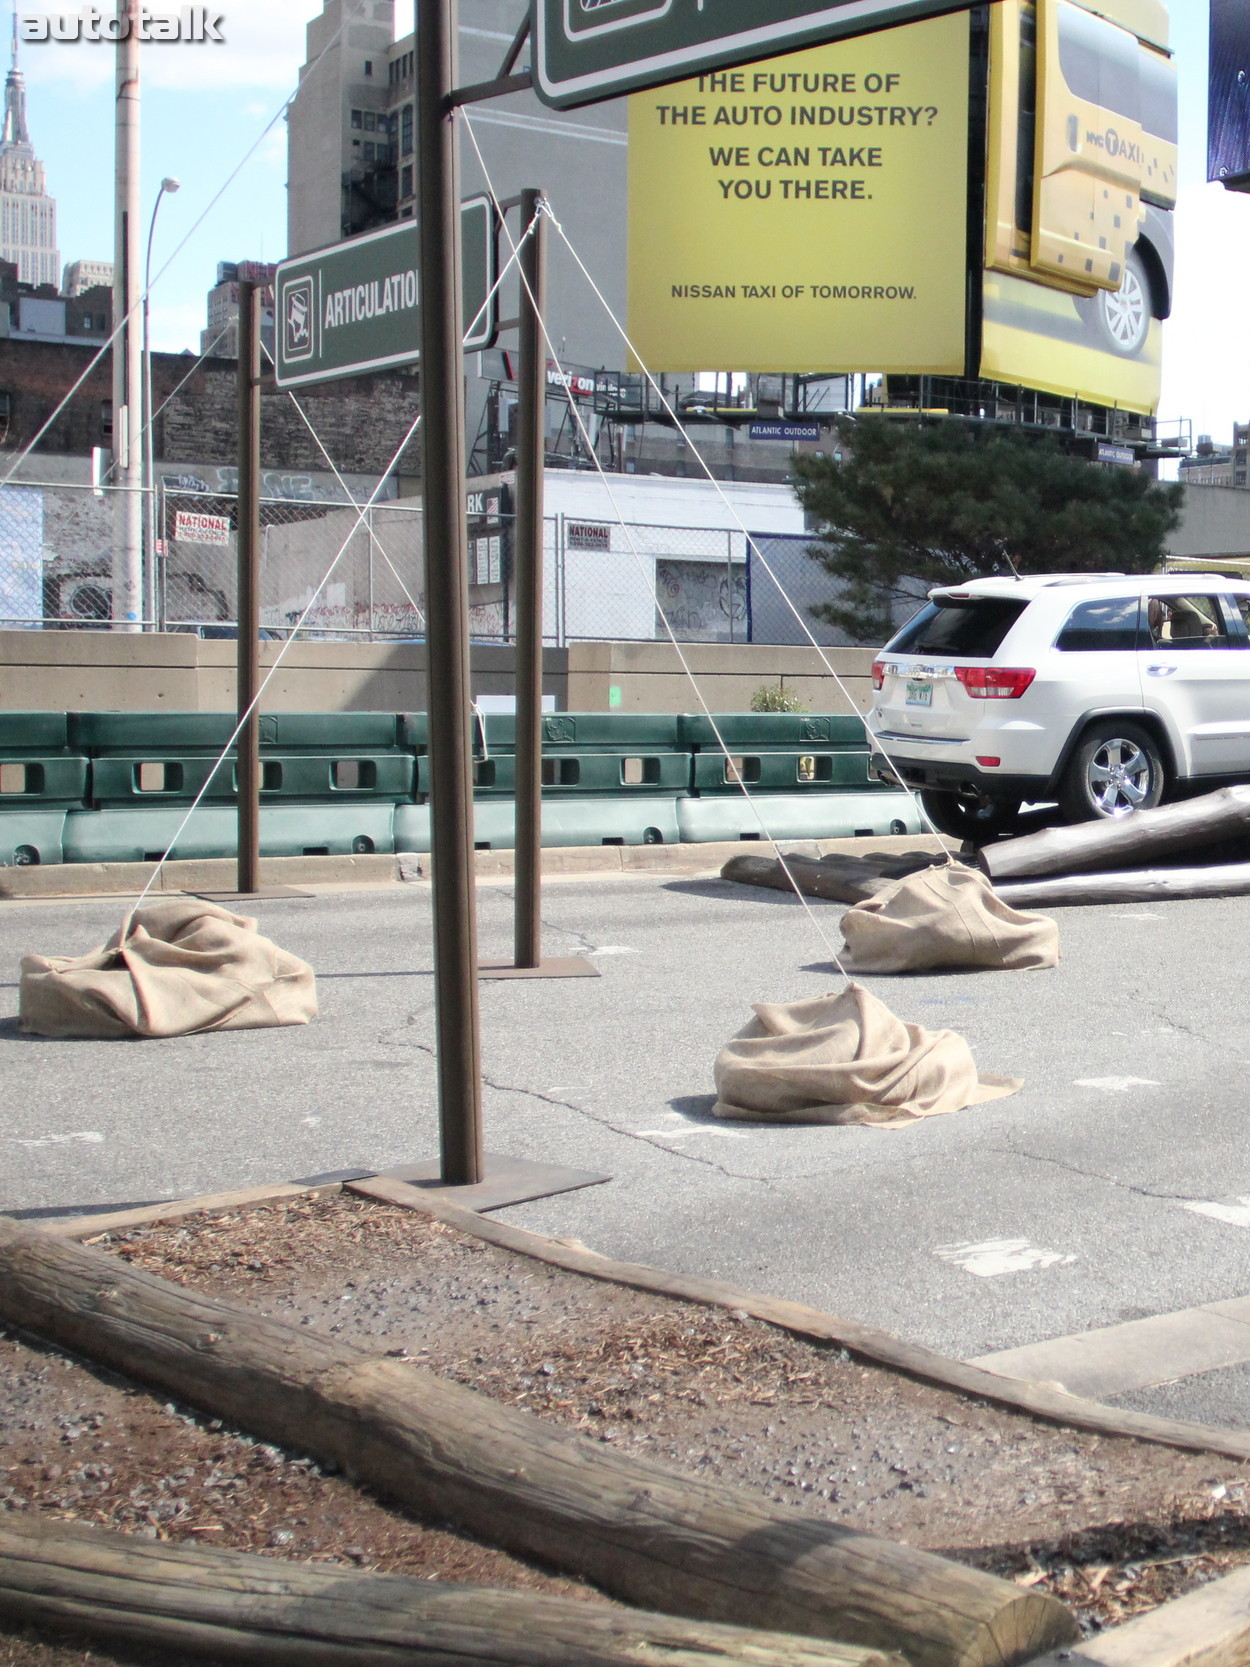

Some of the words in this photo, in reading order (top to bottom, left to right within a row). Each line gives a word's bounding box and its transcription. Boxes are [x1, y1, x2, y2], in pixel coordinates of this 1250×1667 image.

[698, 73, 745, 93] THE
[752, 73, 856, 93] FUTURE
[863, 73, 900, 93] OF
[656, 106, 706, 126] THE
[713, 106, 783, 126] AUTO
[790, 106, 939, 126] INDUSTRY?
[1105, 128, 1140, 164] TAXI
[708, 147, 750, 167] WE
[757, 146, 810, 167] CAN
[817, 147, 883, 167] TAKE
[717, 180, 772, 200] YOU
[778, 180, 873, 200] THERE.
[324, 269, 419, 329] ARTICULATIO
[671, 285, 735, 298] NISSAN
[741, 285, 776, 298] TAXI
[781, 285, 804, 299] OF
[810, 285, 917, 300] TOMORROW.
[547, 370, 595, 392] verizon
[751, 426, 782, 435] ATLANTIC
[784, 427, 817, 436] OUTDOOR
[467, 492, 483, 512] RK
[179, 514, 227, 531] NATIONAL
[569, 525, 608, 538] NATIONAL
